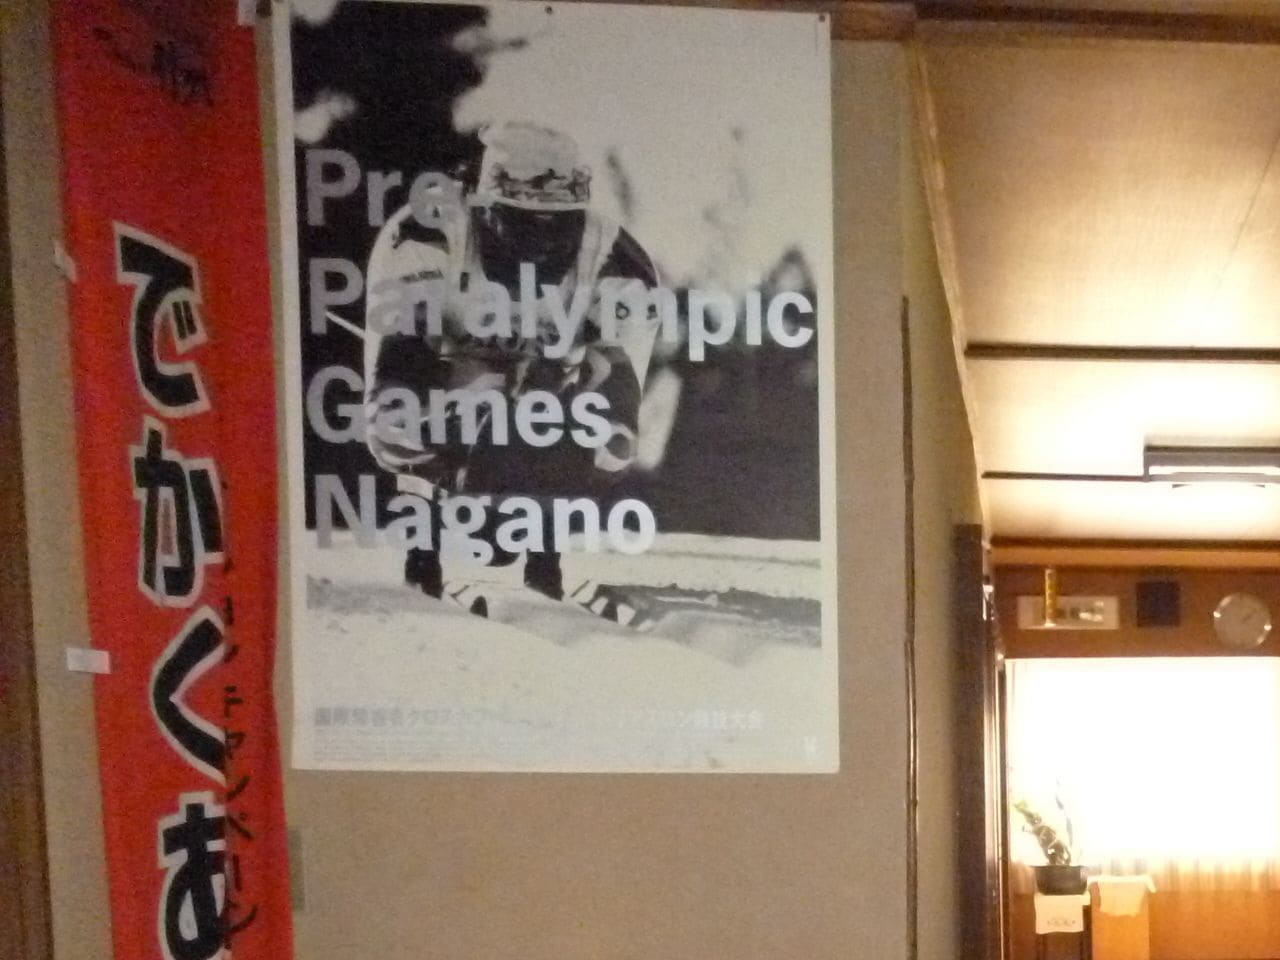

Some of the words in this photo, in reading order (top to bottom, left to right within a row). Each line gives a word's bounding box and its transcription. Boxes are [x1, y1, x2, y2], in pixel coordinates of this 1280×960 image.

[306, 148, 459, 228] Pre
[309, 256, 816, 362] Paralympic
[306, 365, 612, 449] Games
[314, 473, 656, 568] Nagano
